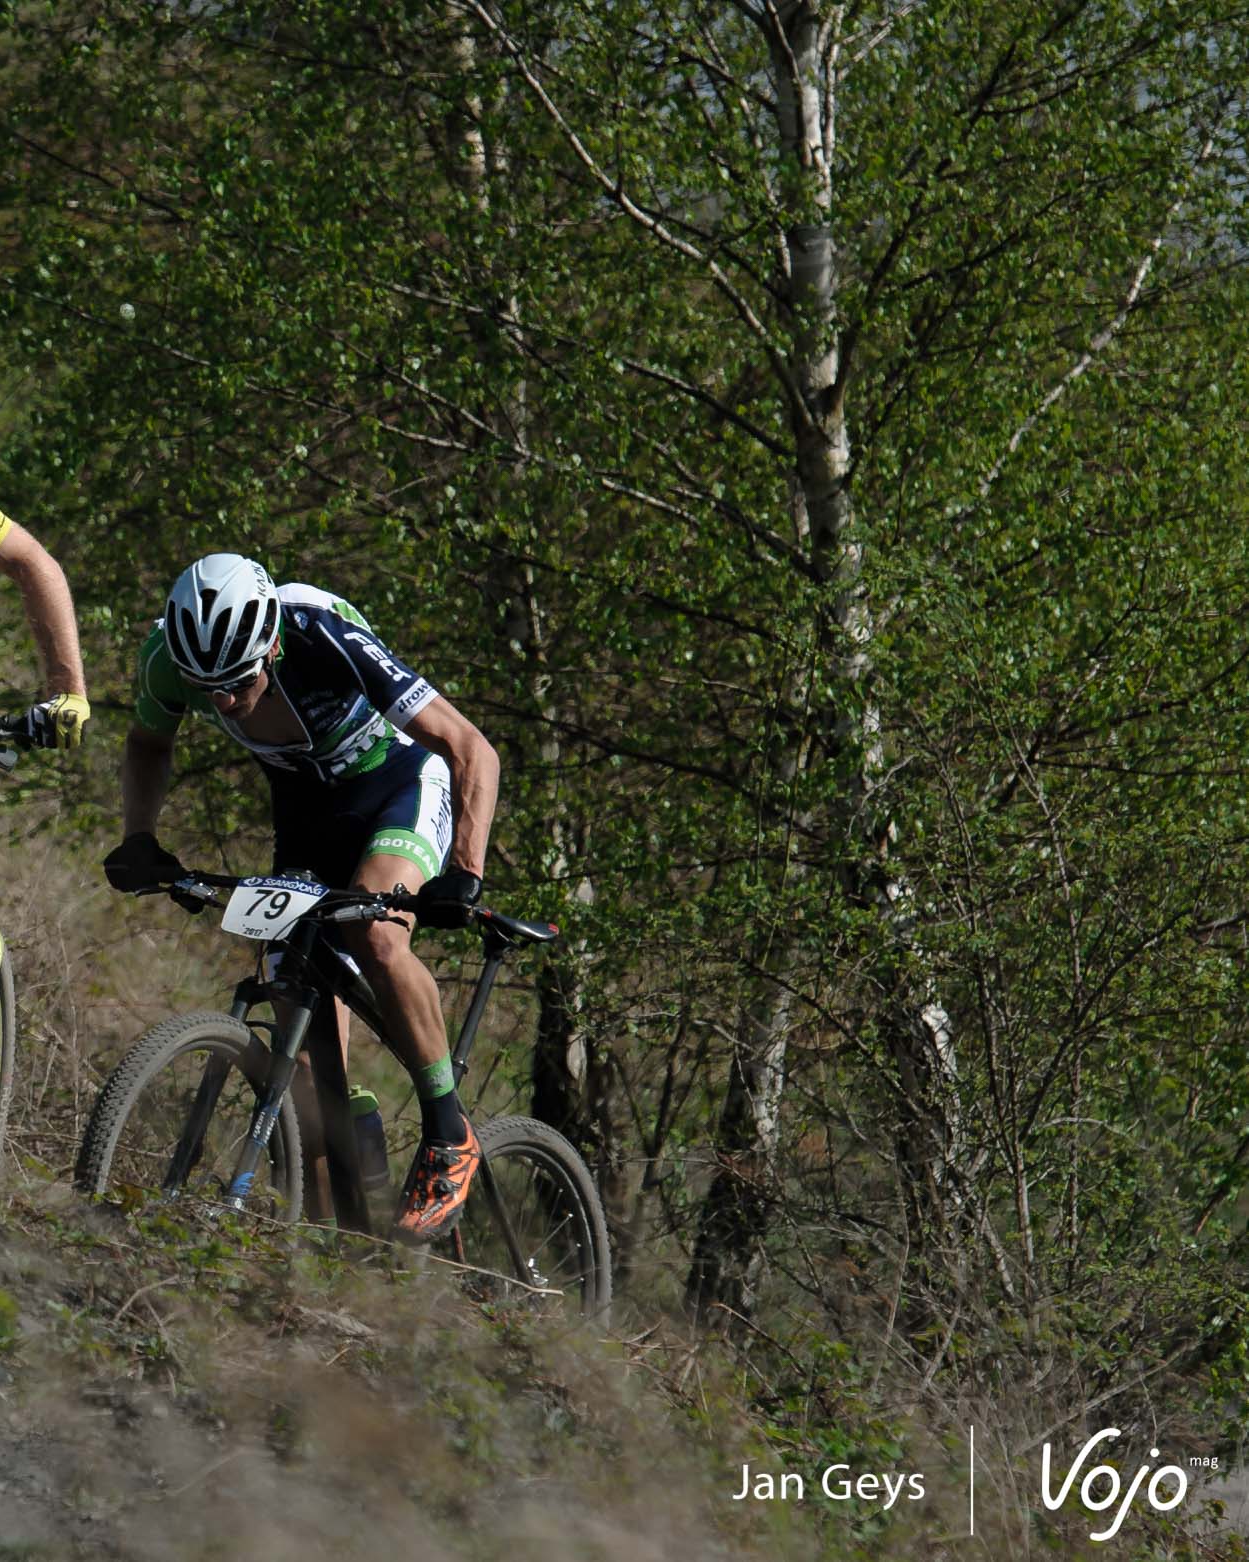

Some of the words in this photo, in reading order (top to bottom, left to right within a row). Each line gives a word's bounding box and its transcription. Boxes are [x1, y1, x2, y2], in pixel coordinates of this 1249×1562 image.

[343, 632, 412, 682] FELT
[262, 878, 324, 896] SSANGYONG
[244, 888, 292, 920] 79
[242, 927, 264, 938] 2017
